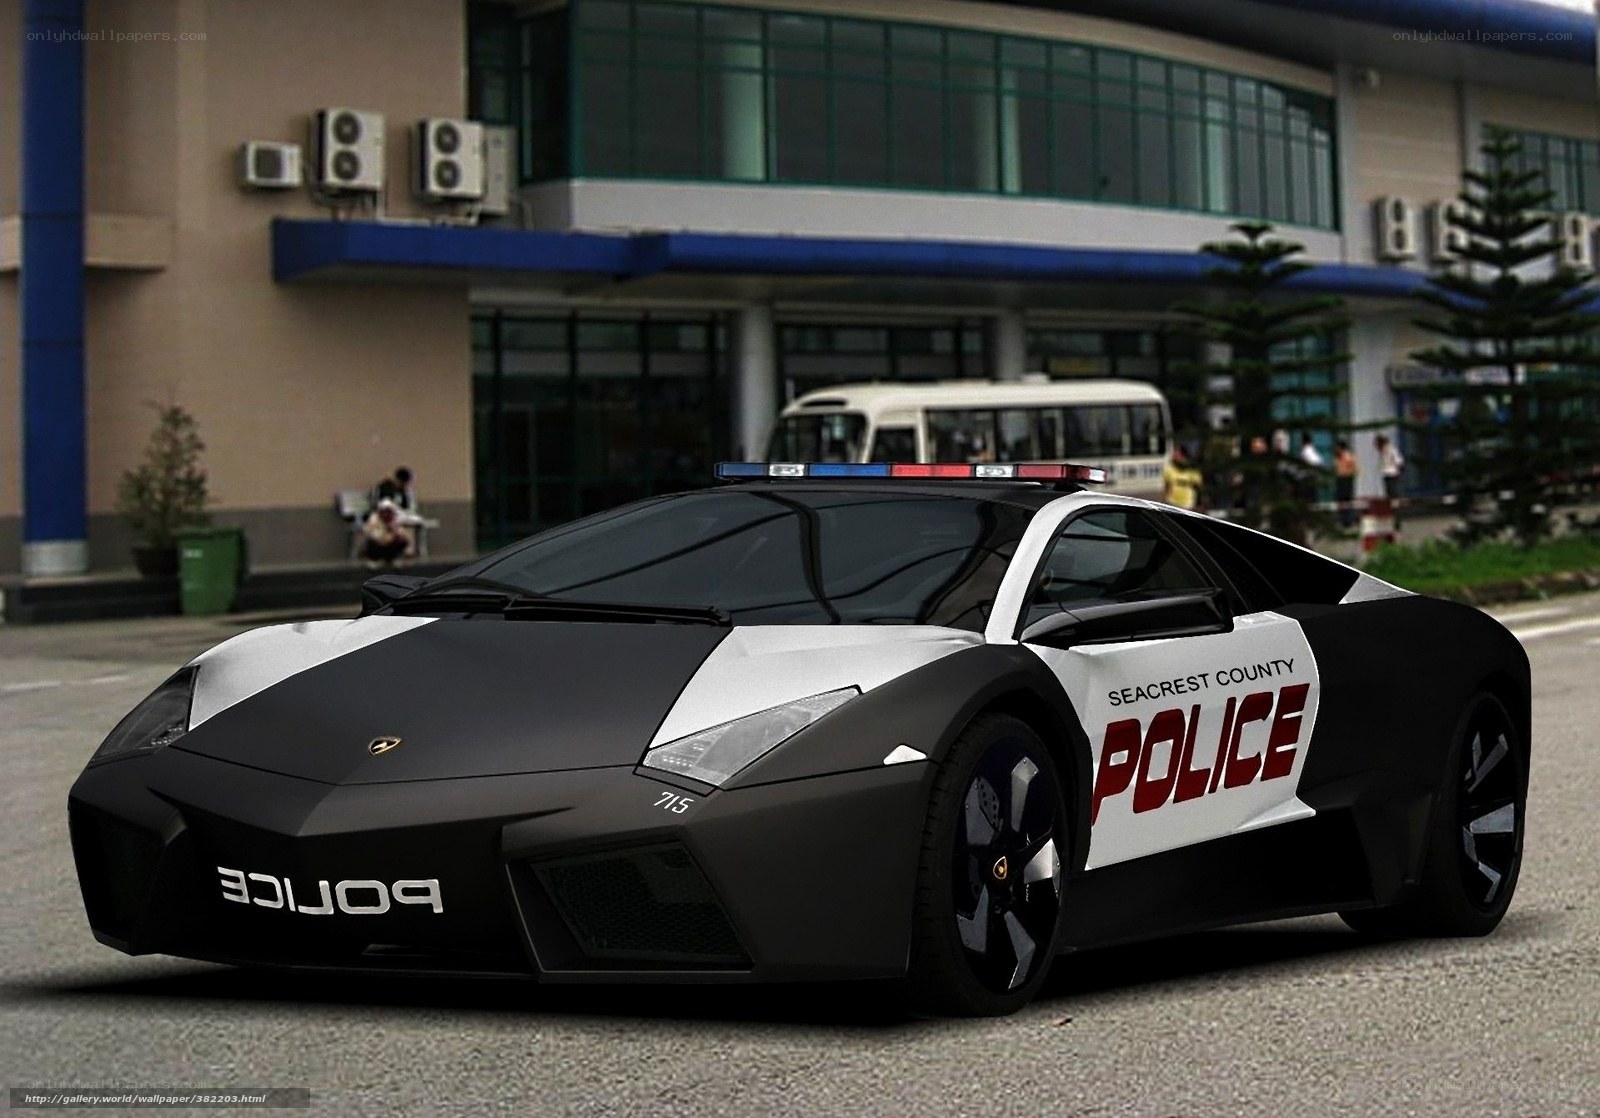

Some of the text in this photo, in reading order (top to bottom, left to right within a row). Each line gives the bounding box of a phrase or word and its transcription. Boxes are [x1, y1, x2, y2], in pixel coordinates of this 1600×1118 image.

[1108, 658, 1294, 706] SEACREST COUNTY
[1091, 683, 1310, 826] POLICE
[653, 791, 694, 813] 715
